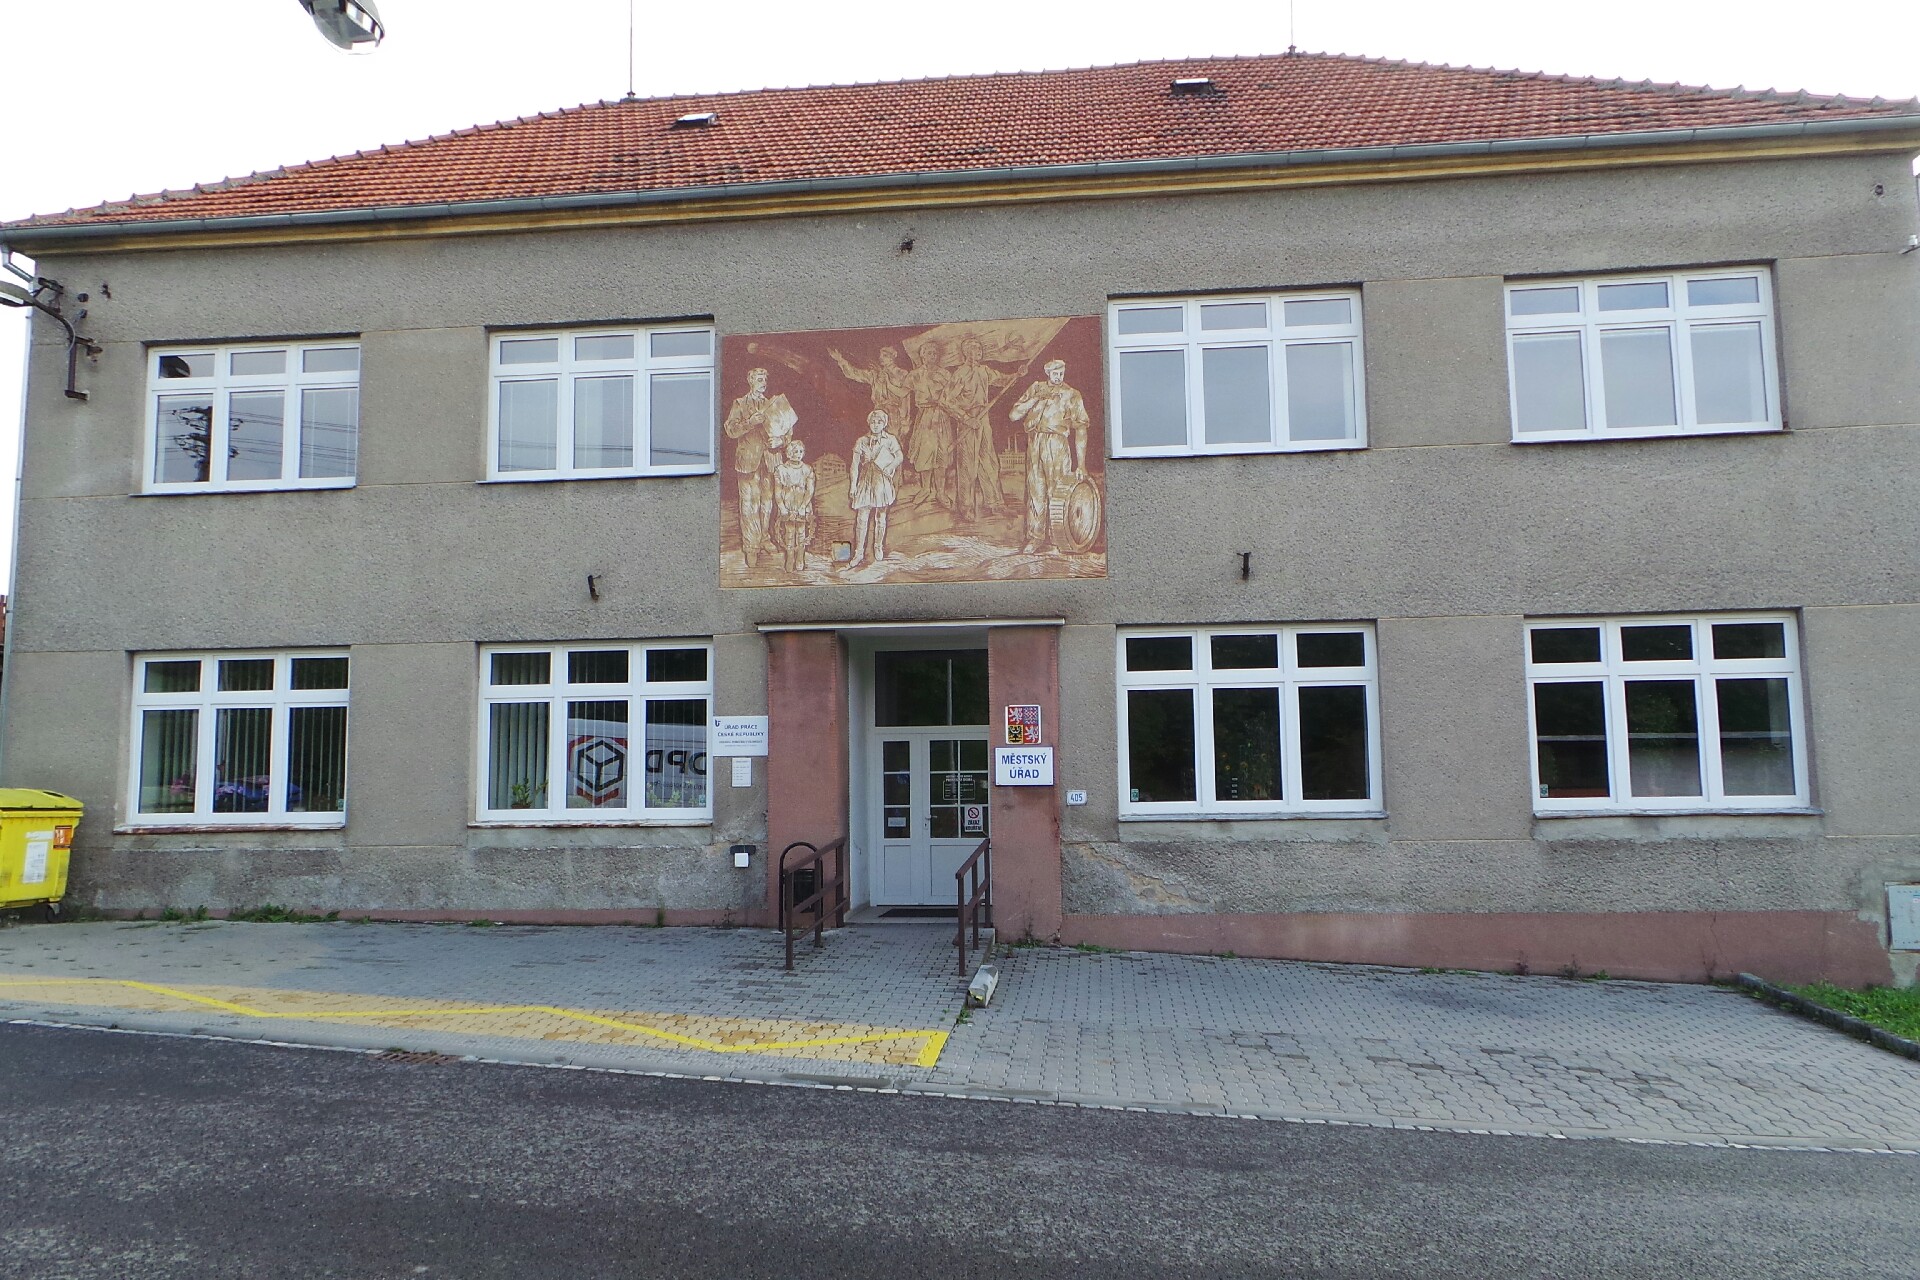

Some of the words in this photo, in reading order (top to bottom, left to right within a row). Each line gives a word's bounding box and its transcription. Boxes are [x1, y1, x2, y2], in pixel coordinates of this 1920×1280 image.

[1001, 752, 1047, 765] MĚSTSKÝ
[1009, 766, 1040, 779] ÚŘAD
[1070, 793, 1083, 802] 405
